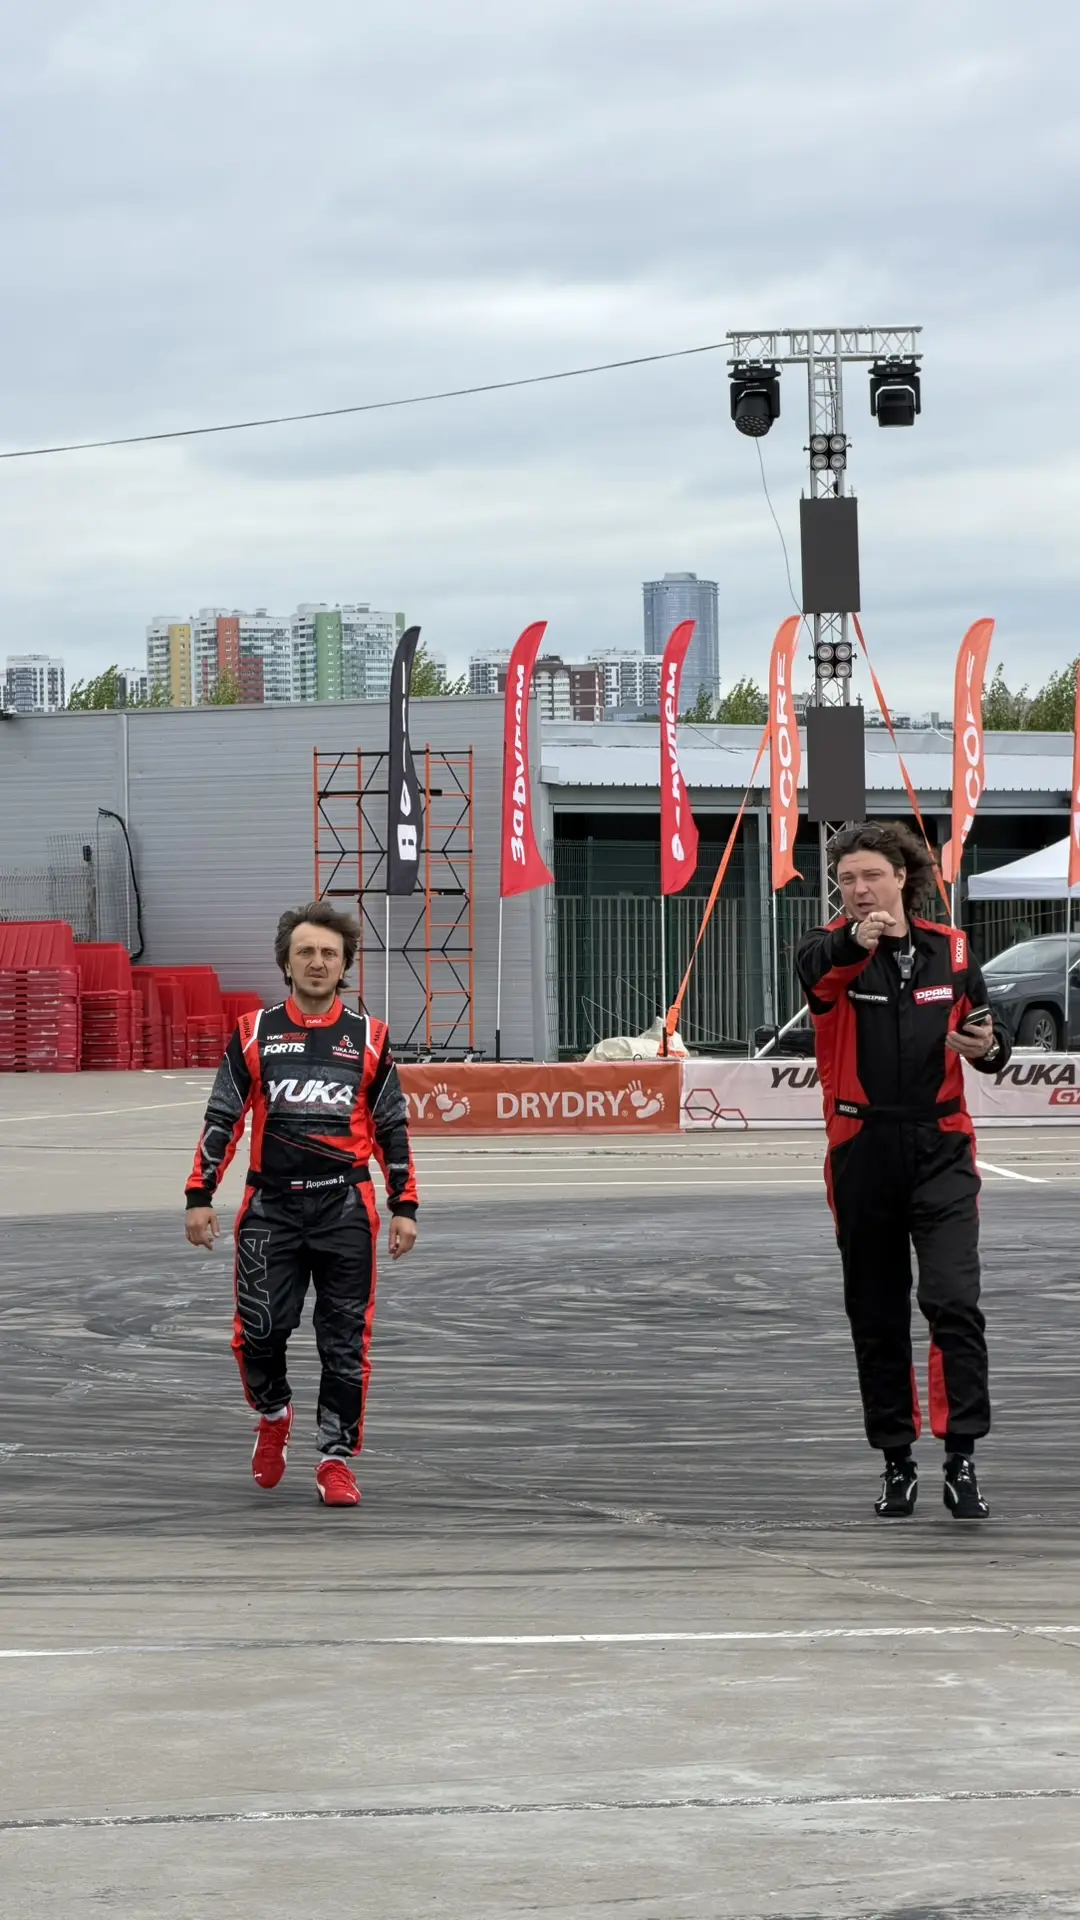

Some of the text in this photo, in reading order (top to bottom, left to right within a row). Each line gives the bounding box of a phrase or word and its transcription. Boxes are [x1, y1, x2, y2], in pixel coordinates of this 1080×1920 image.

[263, 1042, 306, 1056] FORTIS
[993, 1063, 1076, 1086] YUKA
[267, 1079, 354, 1106] YUKA
[496, 1091, 625, 1119] DRYDRY
[306, 1175, 345, 1189] Дорохов Д
